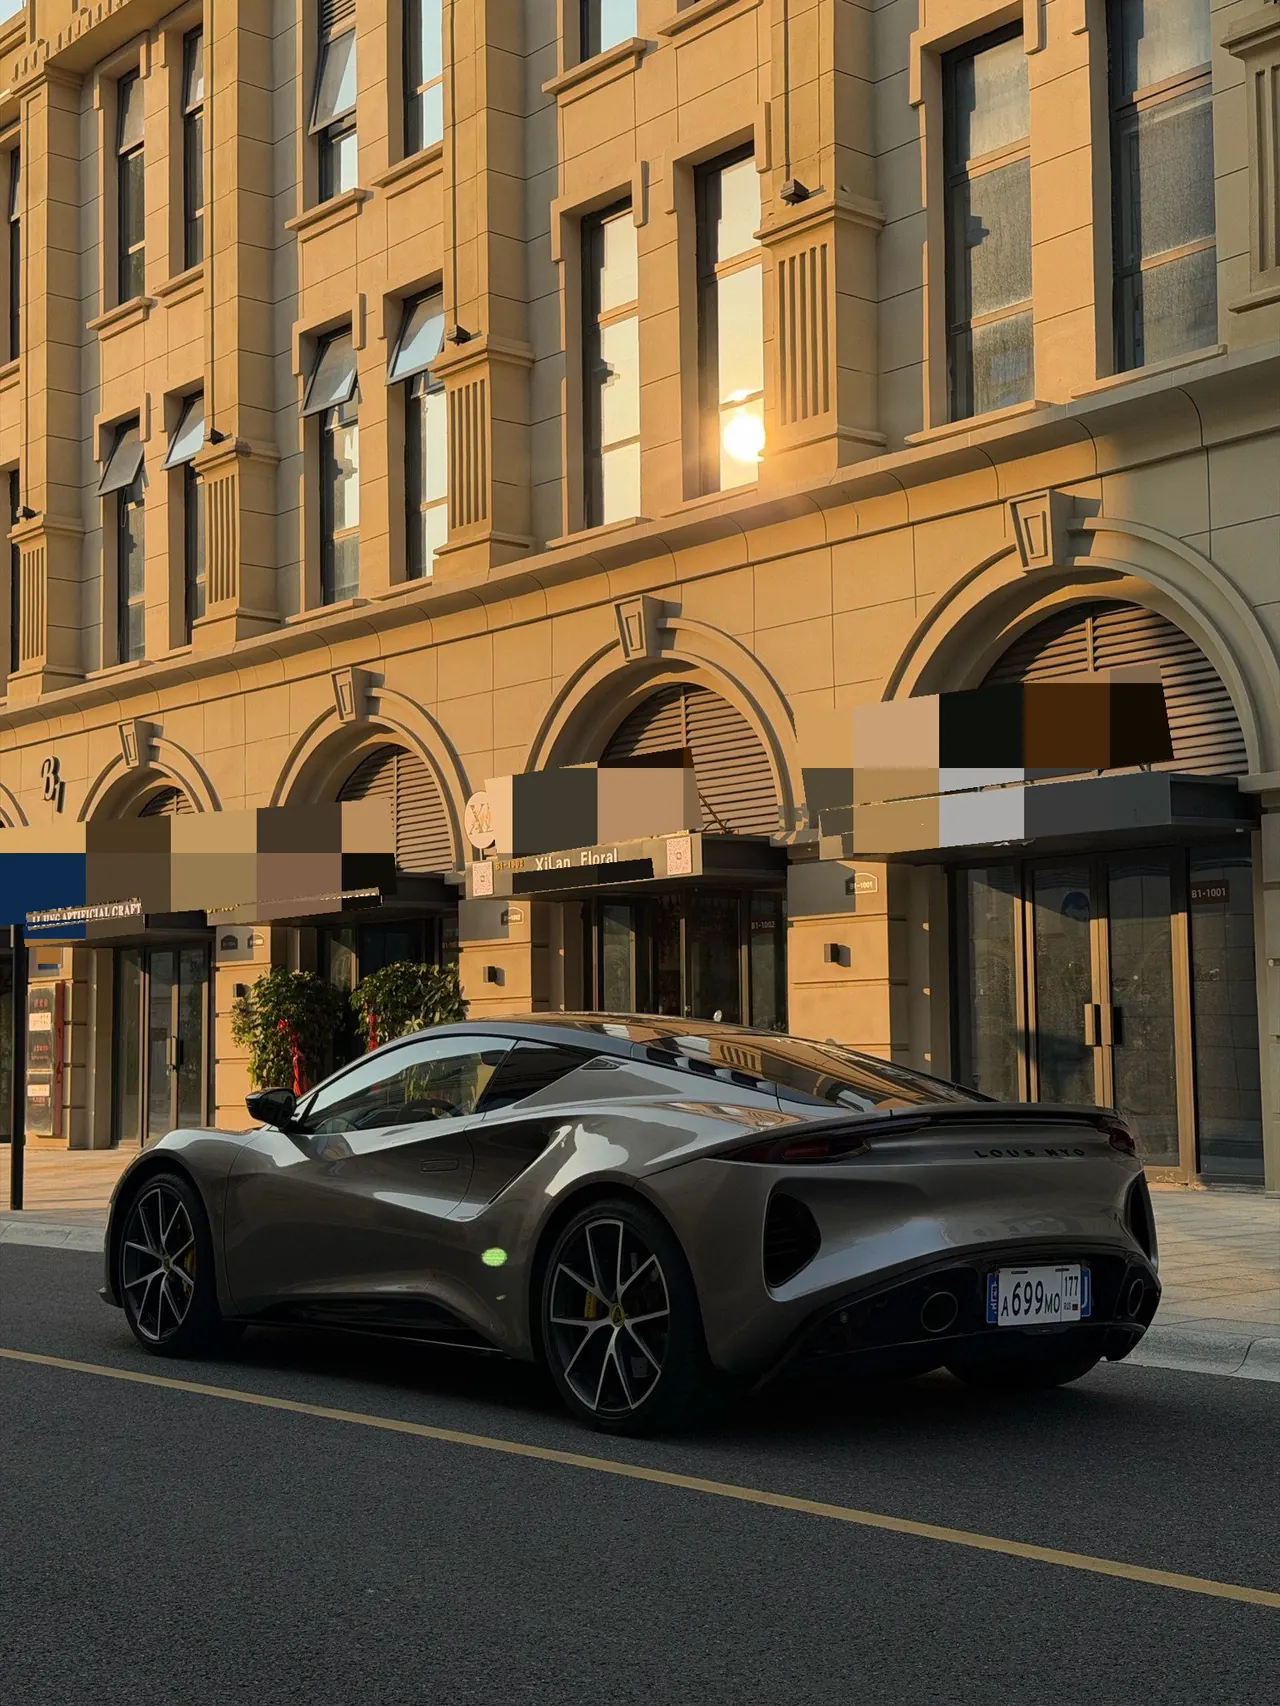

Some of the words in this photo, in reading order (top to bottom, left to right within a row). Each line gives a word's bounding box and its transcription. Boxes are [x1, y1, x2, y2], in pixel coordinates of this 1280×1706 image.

[535, 856, 571, 871] XiLan
[580, 848, 618, 866] Floral
[1191, 888, 1226, 898] B1-1001
[112, 903, 142, 916] CRAFT
[1064, 1276, 1079, 1297] 177
